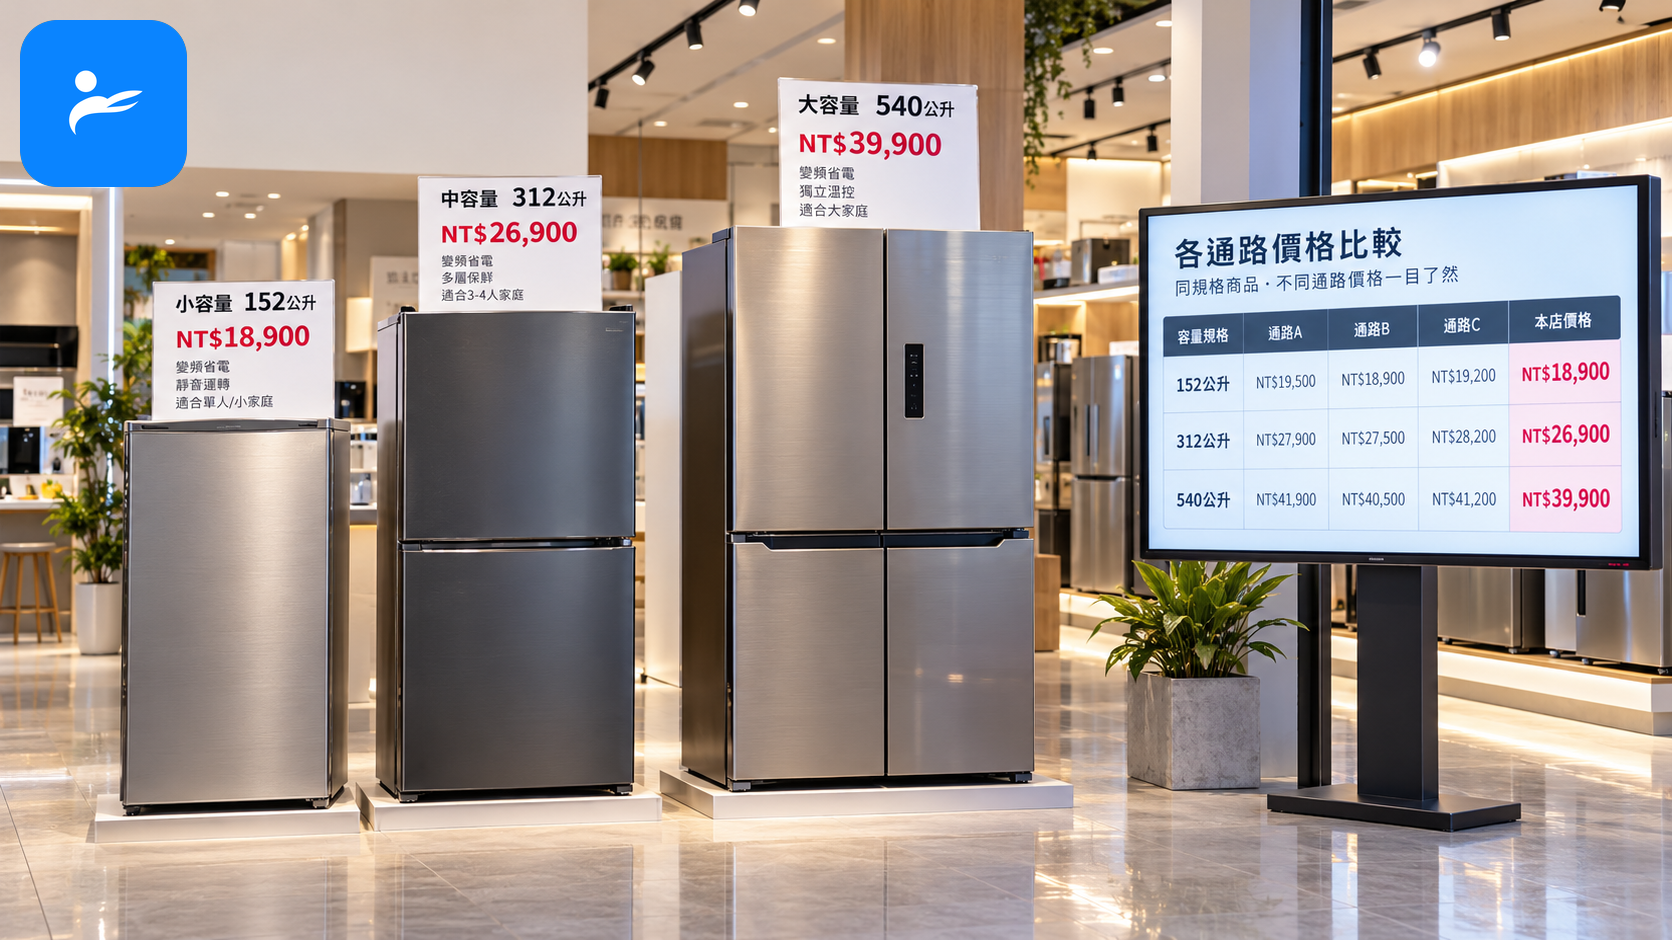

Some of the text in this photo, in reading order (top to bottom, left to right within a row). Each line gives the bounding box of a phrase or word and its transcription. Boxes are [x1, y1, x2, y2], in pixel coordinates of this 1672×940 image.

[799, 94, 954, 117] 大容量 540公升
[800, 131, 941, 160] NT$39,900
[800, 166, 854, 180] 變頻省電
[442, 187, 586, 208] 中容量 312公升
[800, 203, 867, 217] 適合大家庭
[442, 221, 577, 247] NT$26,900
[1174, 226, 1402, 270] 各通路價格比較
[442, 255, 493, 267] 變頻省電
[176, 292, 316, 313] 小容量 152公升
[442, 289, 523, 301] 適合3-4人家庭
[177, 325, 309, 351] NT$18,900
[1178, 312, 1591, 344] 容量規格 通路A 通路B 通路C 本店價格
[177, 360, 229, 374] 變頻省電
[1177, 362, 1609, 392] 152公升 NT$19,500 NT$18,900 NT$19,200 NT$18,900
[1177, 424, 1610, 448] 312公升 NT$27,900 NT$27,500 NT$28,200 NT$26,900
[1177, 488, 1610, 511] 540公升 NT$41,900 NT$40,500 NT$41,200 NT$39,900
